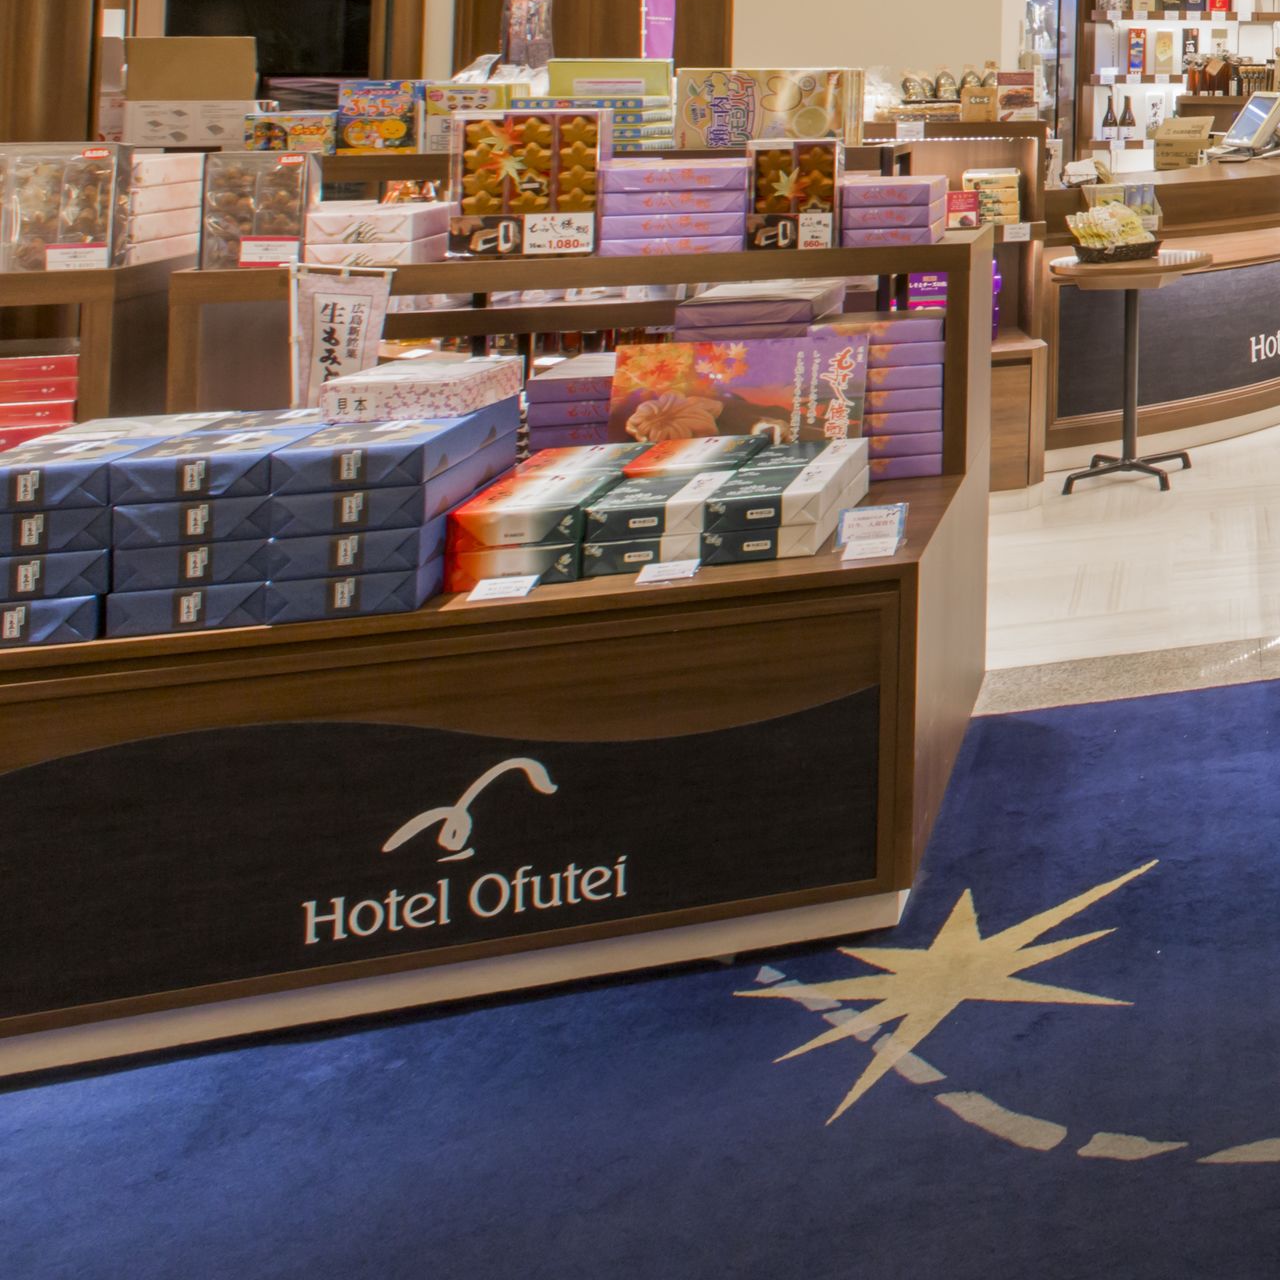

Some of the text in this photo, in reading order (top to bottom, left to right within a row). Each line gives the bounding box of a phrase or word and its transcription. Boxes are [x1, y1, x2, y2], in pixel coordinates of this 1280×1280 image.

[343, 97, 407, 116] ぷっちょ
[336, 397, 368, 416] 見本
[301, 855, 628, 945] Hotel Ofutei
